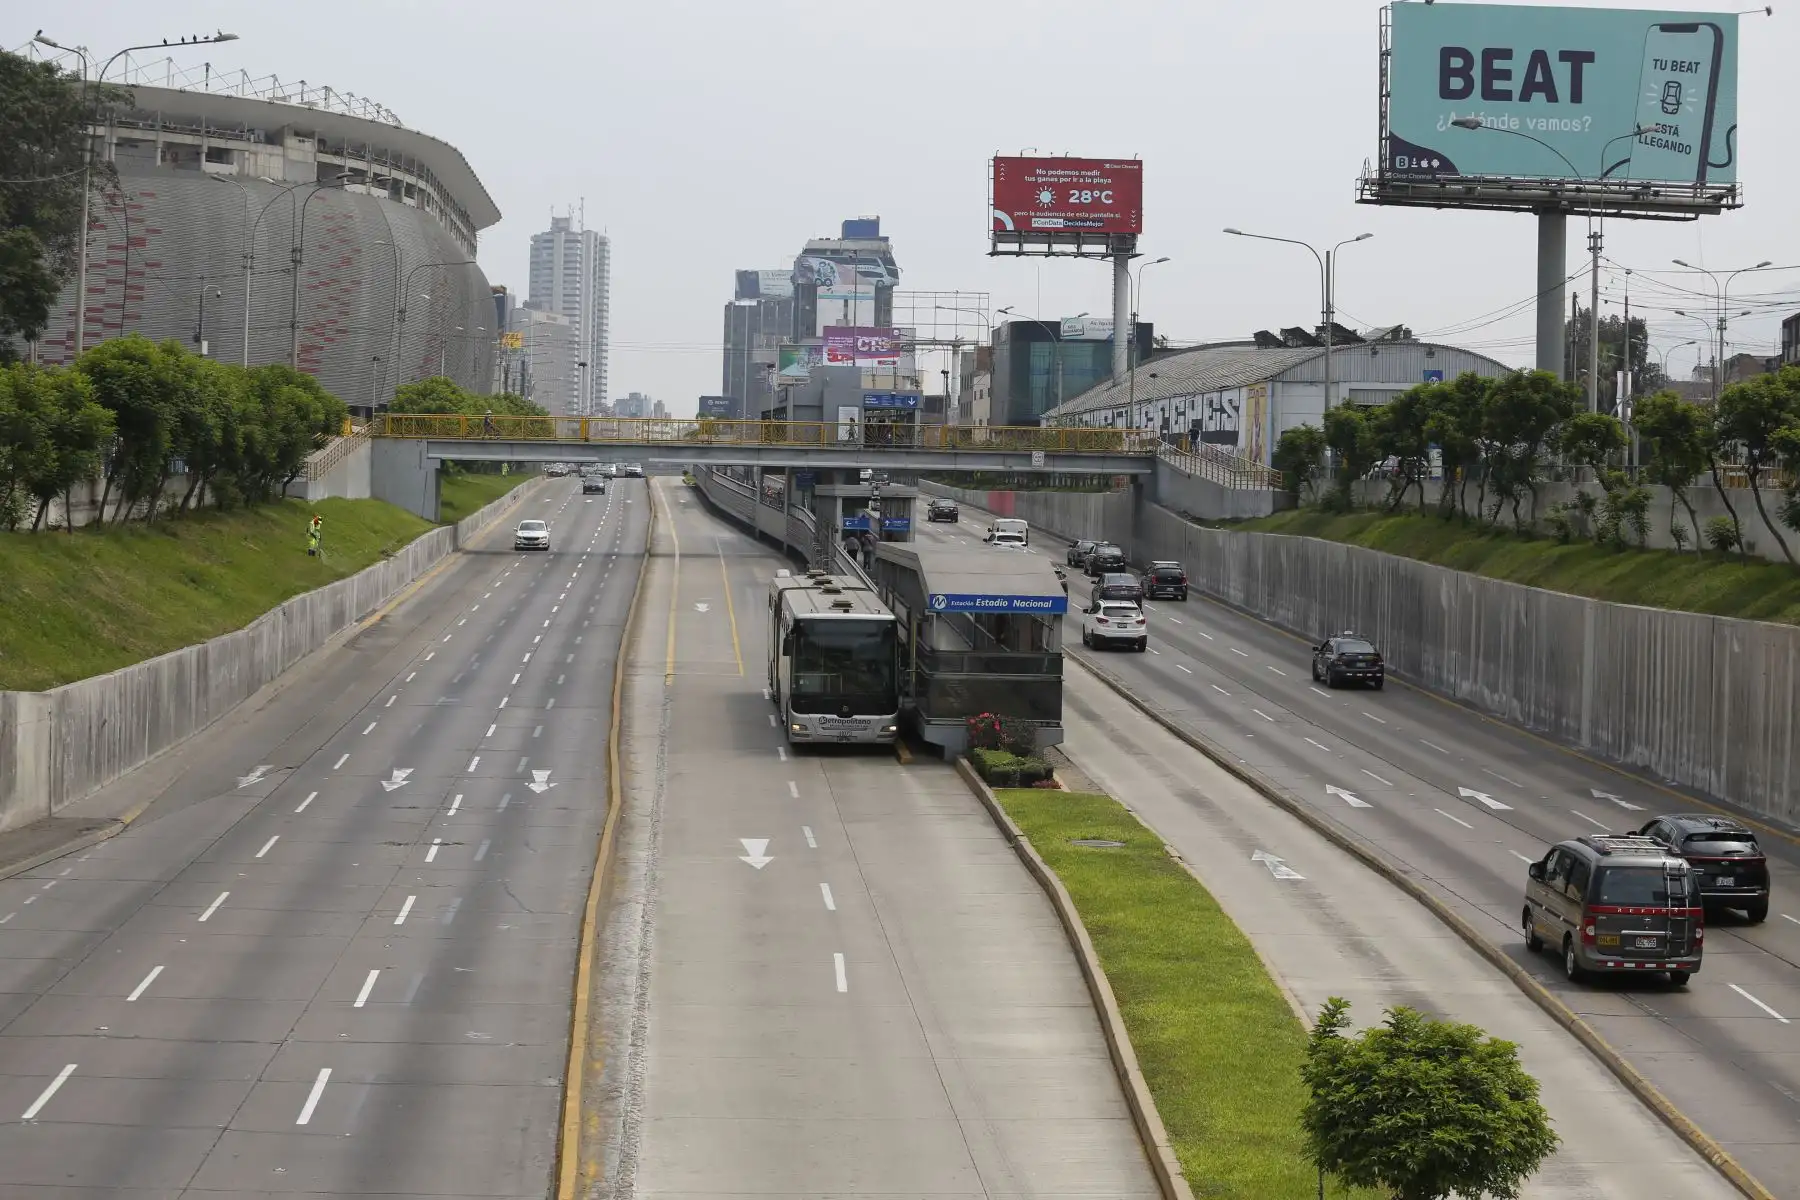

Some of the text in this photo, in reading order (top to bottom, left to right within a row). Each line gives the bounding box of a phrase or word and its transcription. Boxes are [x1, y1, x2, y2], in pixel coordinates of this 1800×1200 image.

[1652, 58, 1701, 74] TU BEAT
[1438, 46, 1596, 104] BEAT
[1526, 116, 1592, 132] vamos?
[1638, 134, 1692, 155] LLEGANDO
[1048, 168, 1080, 176] podemos
[1093, 176, 1112, 185] playa
[1068, 189, 1113, 204] 28°C
[975, 598, 1009, 607] Estadio
[1012, 599, 1053, 608] Nacional
